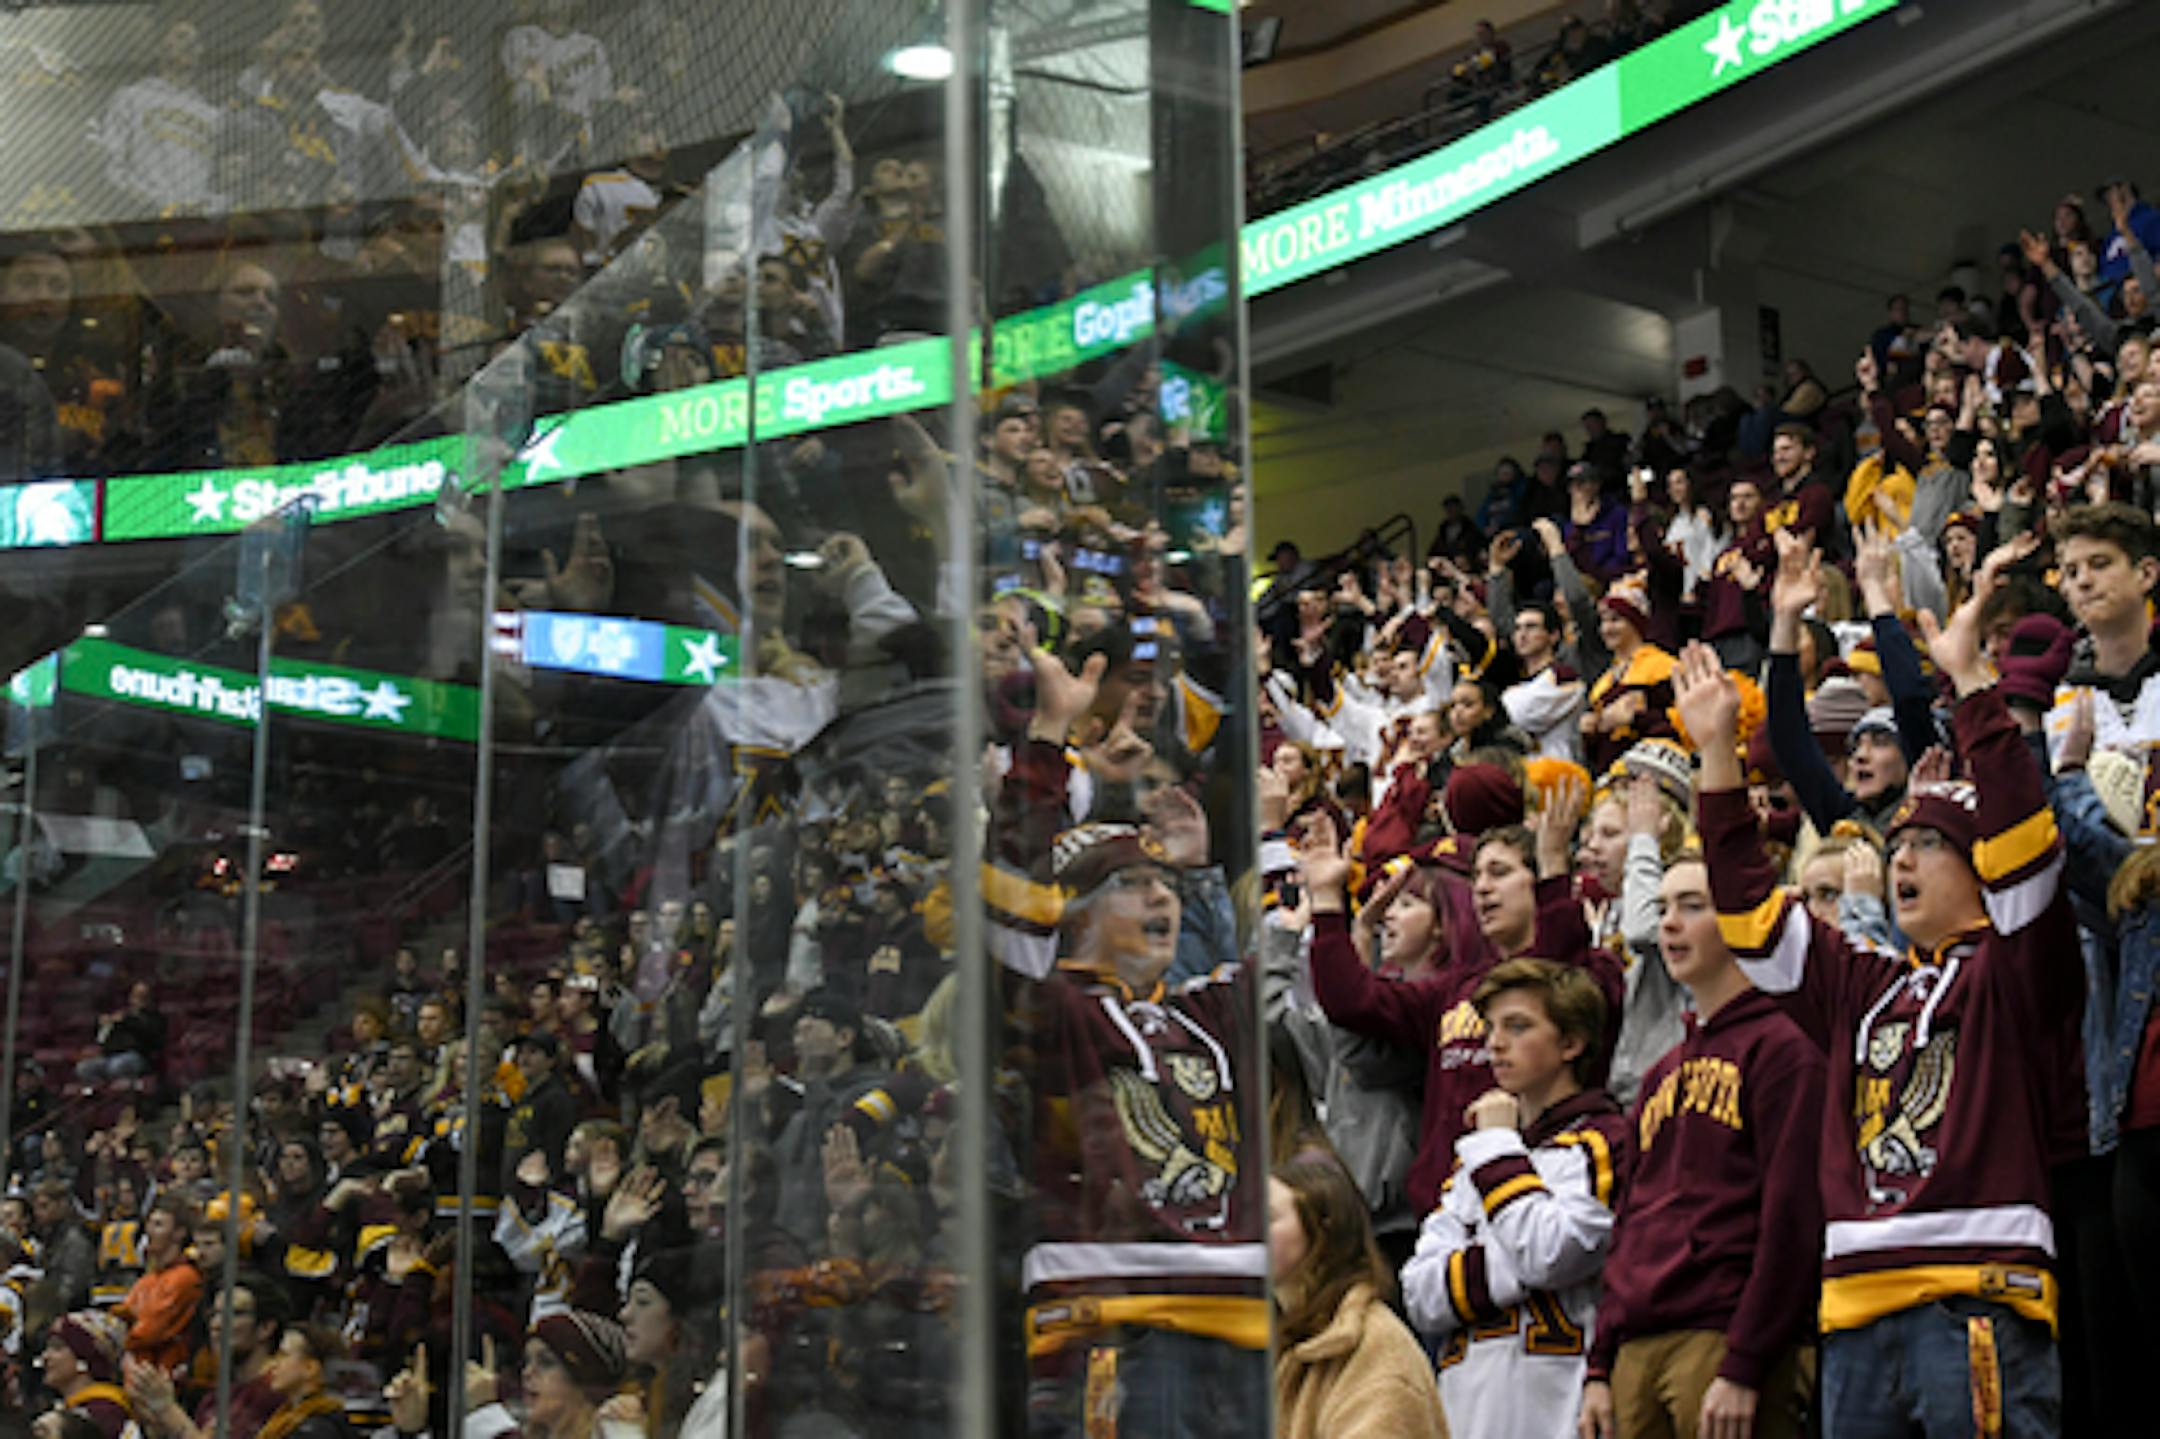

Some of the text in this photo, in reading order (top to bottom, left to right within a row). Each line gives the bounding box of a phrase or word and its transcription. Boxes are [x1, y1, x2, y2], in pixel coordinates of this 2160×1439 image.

[1240, 125, 1561, 281] MORE Minnesota.
[659, 363, 926, 444] MORE Sports.
